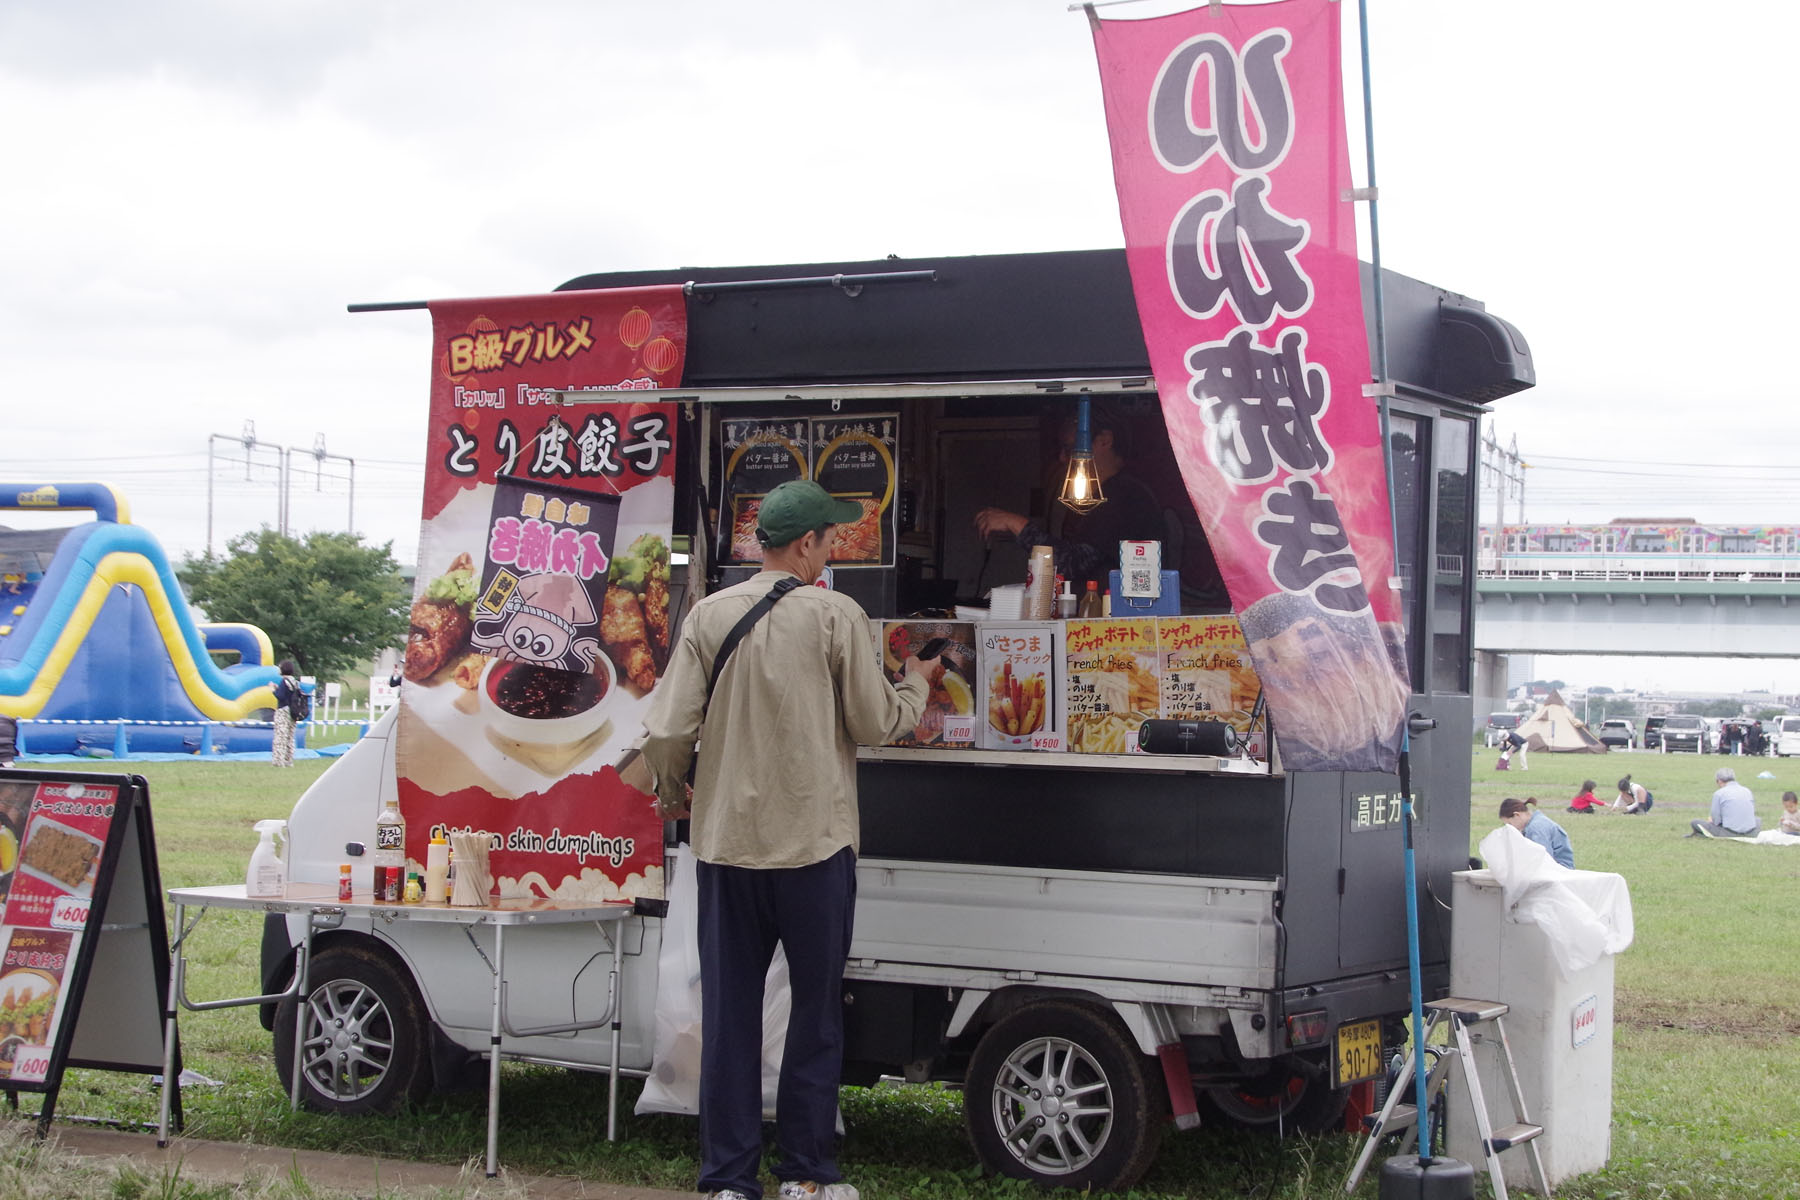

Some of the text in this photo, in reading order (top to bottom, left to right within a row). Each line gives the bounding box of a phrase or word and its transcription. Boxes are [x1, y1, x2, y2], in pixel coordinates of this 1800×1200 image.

[449, 316, 596, 376] B級グルメ
[739, 424, 789, 440] イカ焼き
[829, 423, 876, 438] イカ焼き
[448, 412, 671, 477] とり皮餃子
[1104, 626, 1139, 642] ポテト
[1159, 622, 1242, 640] シャカ ポテト
[998, 635, 1041, 653] さつま
[1074, 636, 1104, 652] シャカ
[1173, 633, 1203, 650] シャカ
[1003, 654, 1052, 665] スティック
[1066, 654, 1133, 670] French fries
[1167, 652, 1242, 669] French fries
[948, 726, 971, 738] ¥600
[1033, 738, 1060, 749] ¥500
[378, 828, 401, 838] おろし
[508, 826, 543, 851] skin
[546, 827, 635, 867] dumplings
[56, 905, 89, 922] ¥600
[17, 1058, 49, 1075] ¥600
